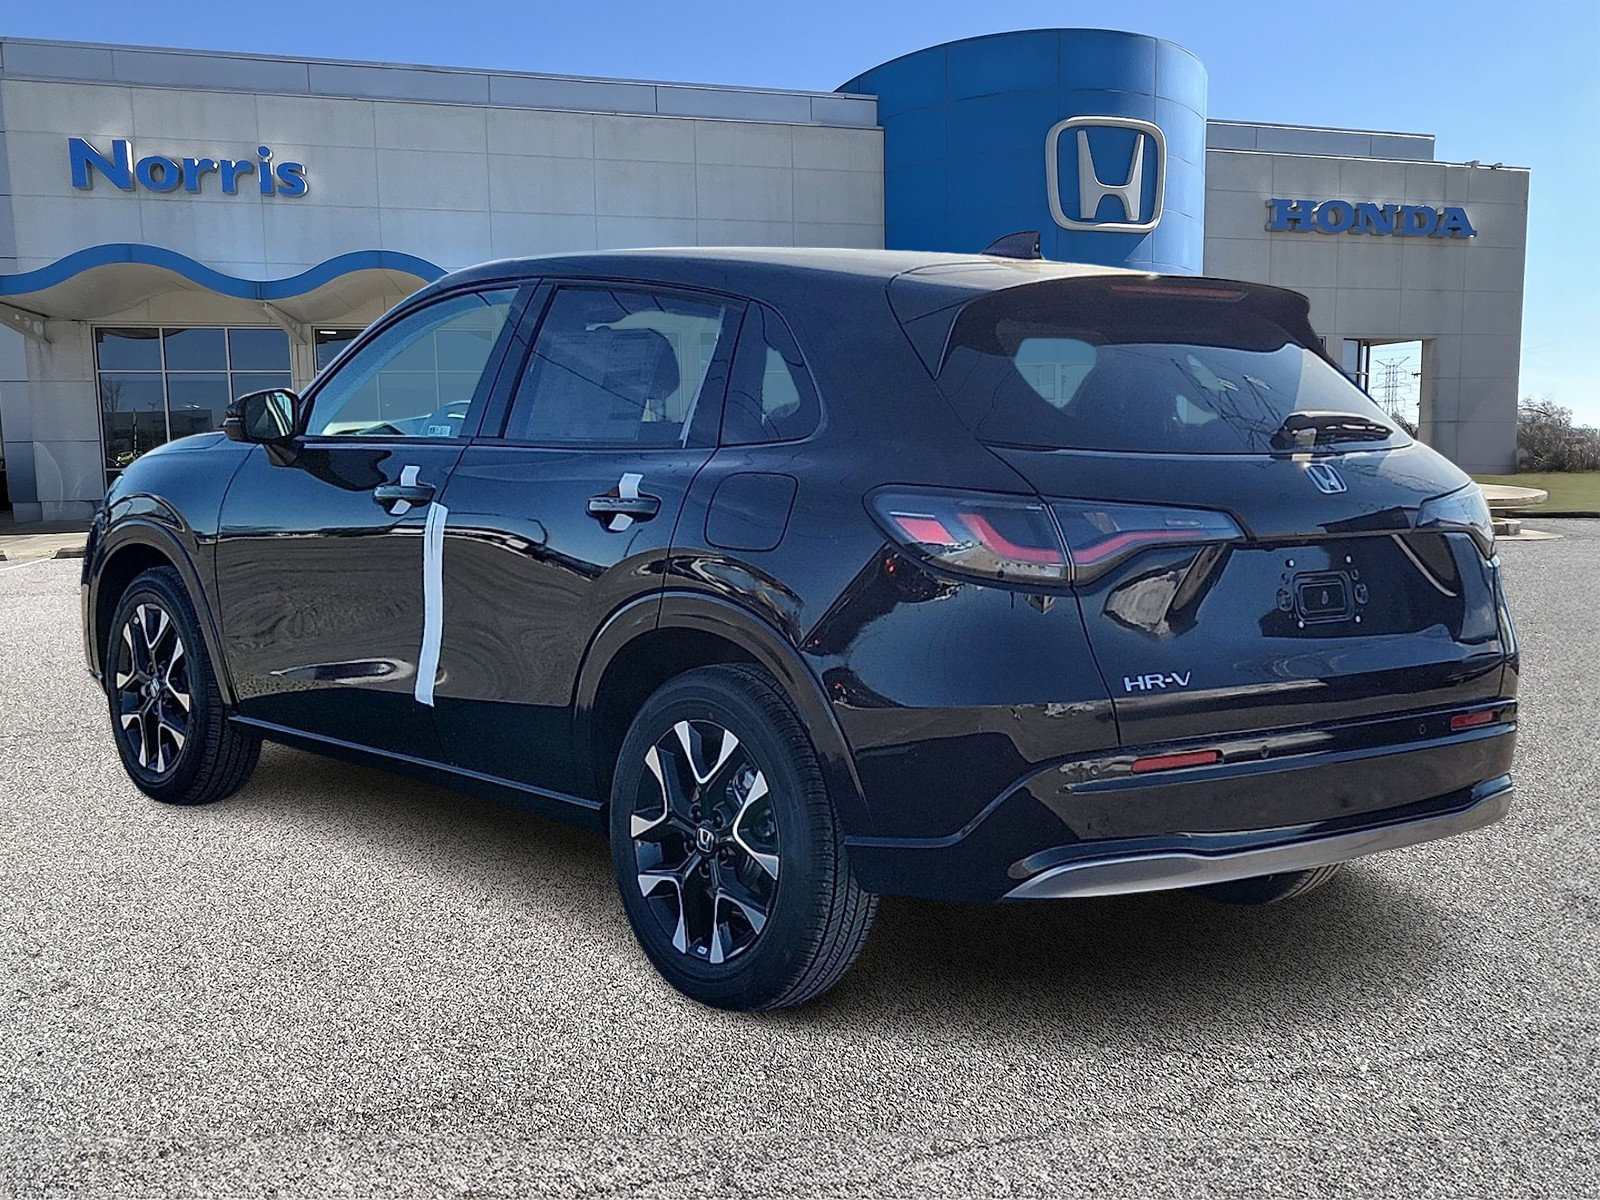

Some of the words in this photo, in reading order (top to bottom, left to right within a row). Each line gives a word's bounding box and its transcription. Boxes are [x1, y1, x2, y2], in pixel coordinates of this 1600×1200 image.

[68, 137, 309, 198] Norris
[1265, 198, 1478, 239] HONDA
[1123, 671, 1191, 692] HR-V
